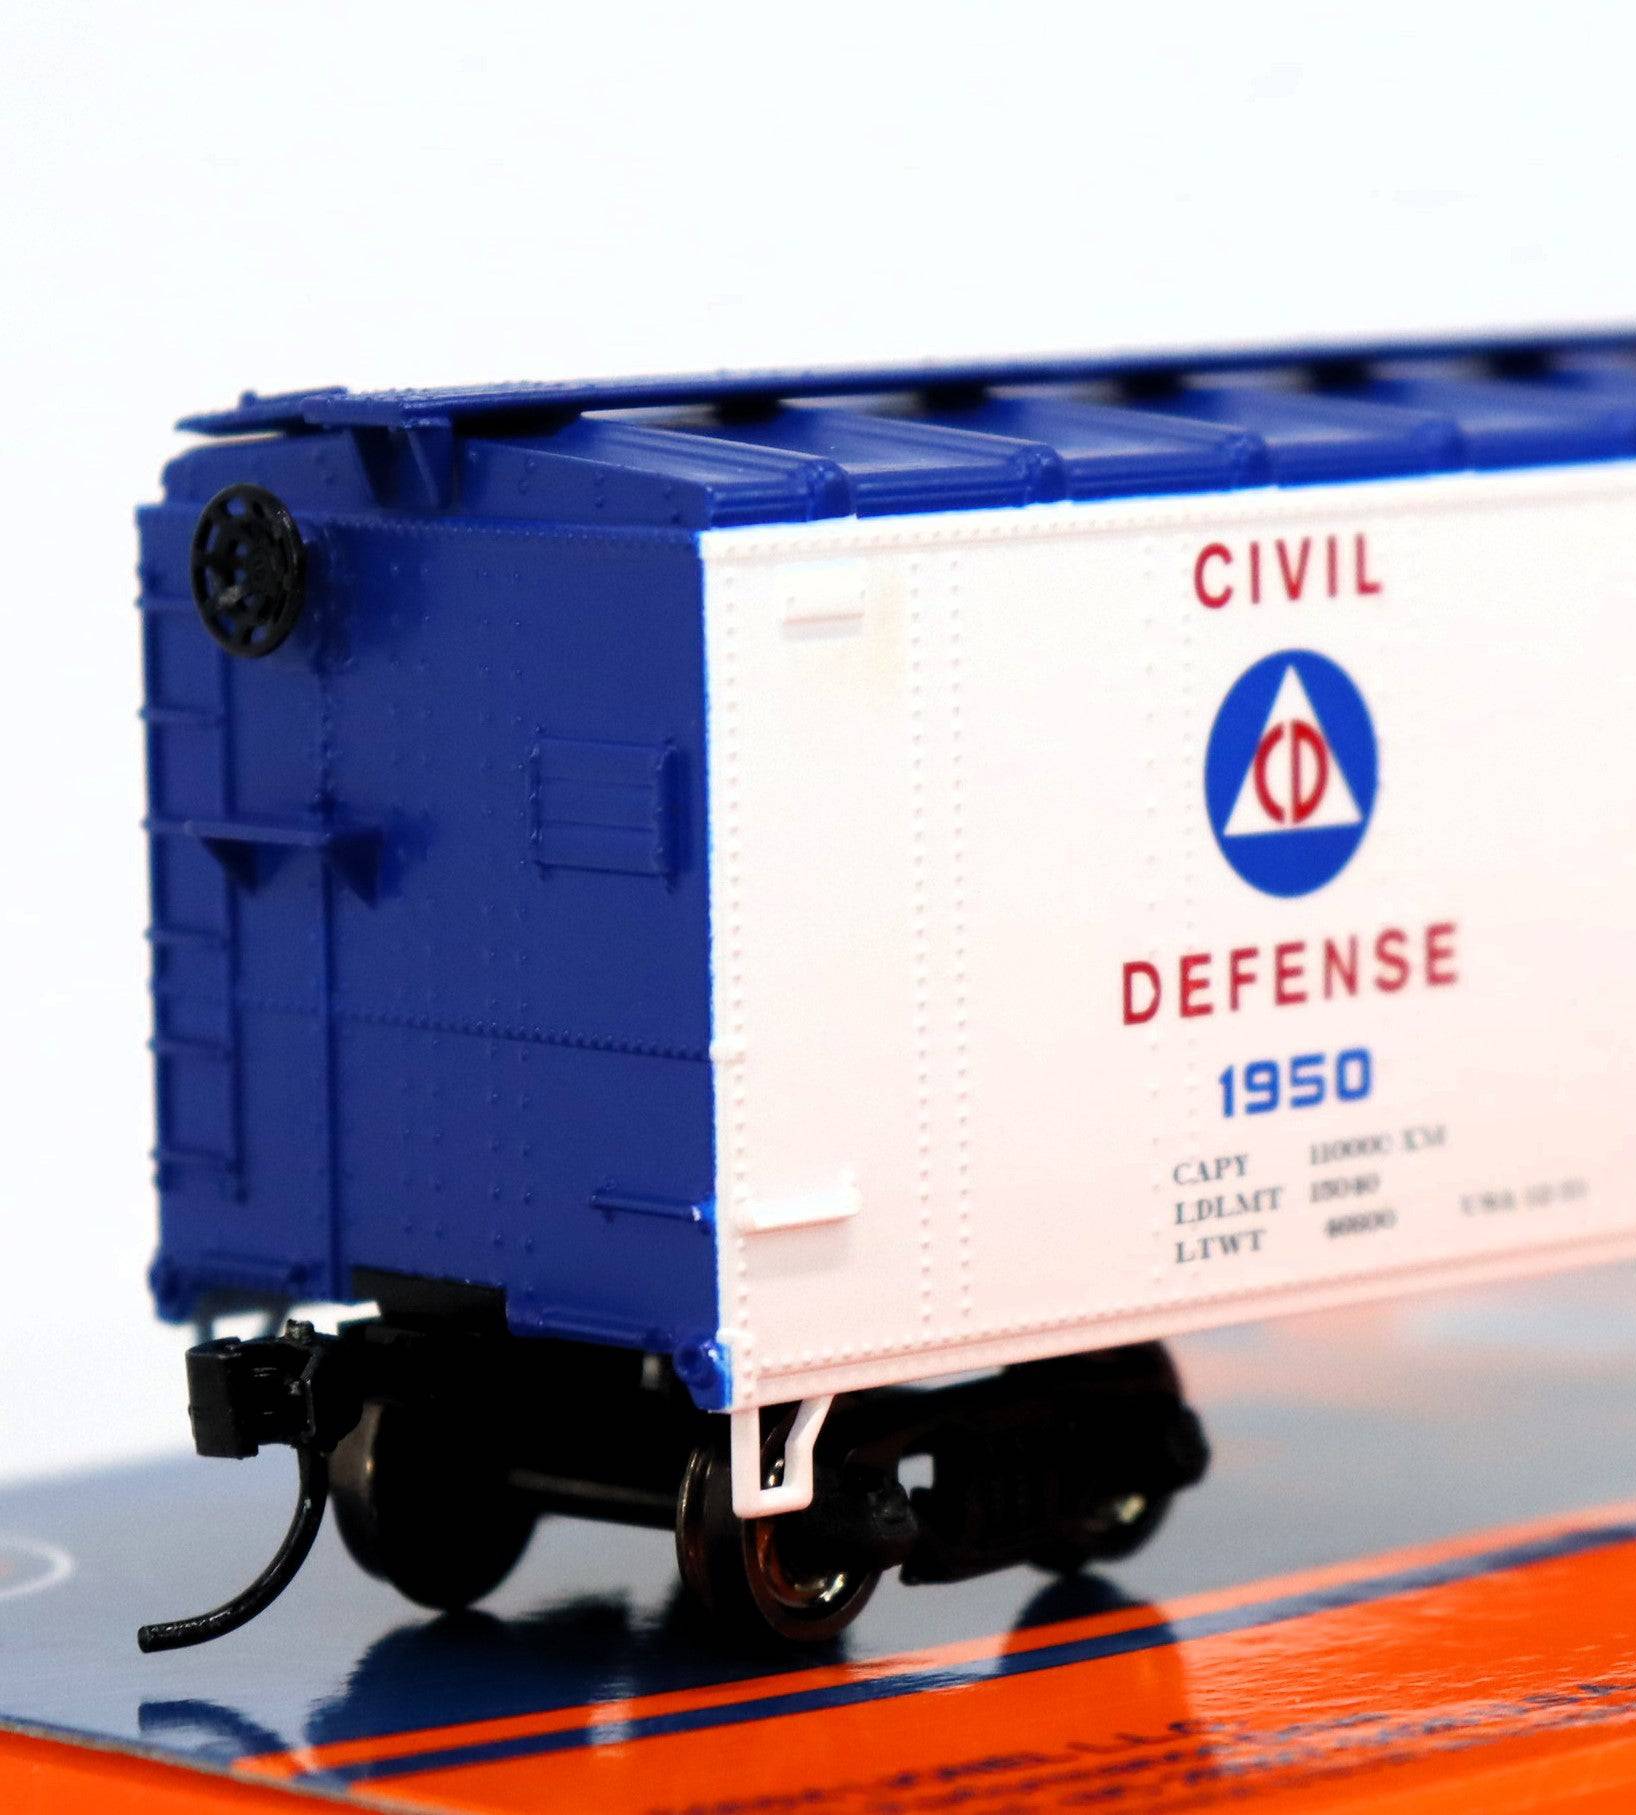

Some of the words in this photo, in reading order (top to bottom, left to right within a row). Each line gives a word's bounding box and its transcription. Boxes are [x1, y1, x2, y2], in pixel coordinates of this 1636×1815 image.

[1193, 534, 1383, 610] CIVIL
[1253, 719, 1330, 824] CD
[1122, 922, 1458, 1026] DEFENSE
[1218, 1047, 1374, 1118] 1950
[1172, 1153, 1248, 1186] CAPY
[1174, 1186, 1283, 1226] LDLMT
[1174, 1228, 1266, 1265] LTWT
